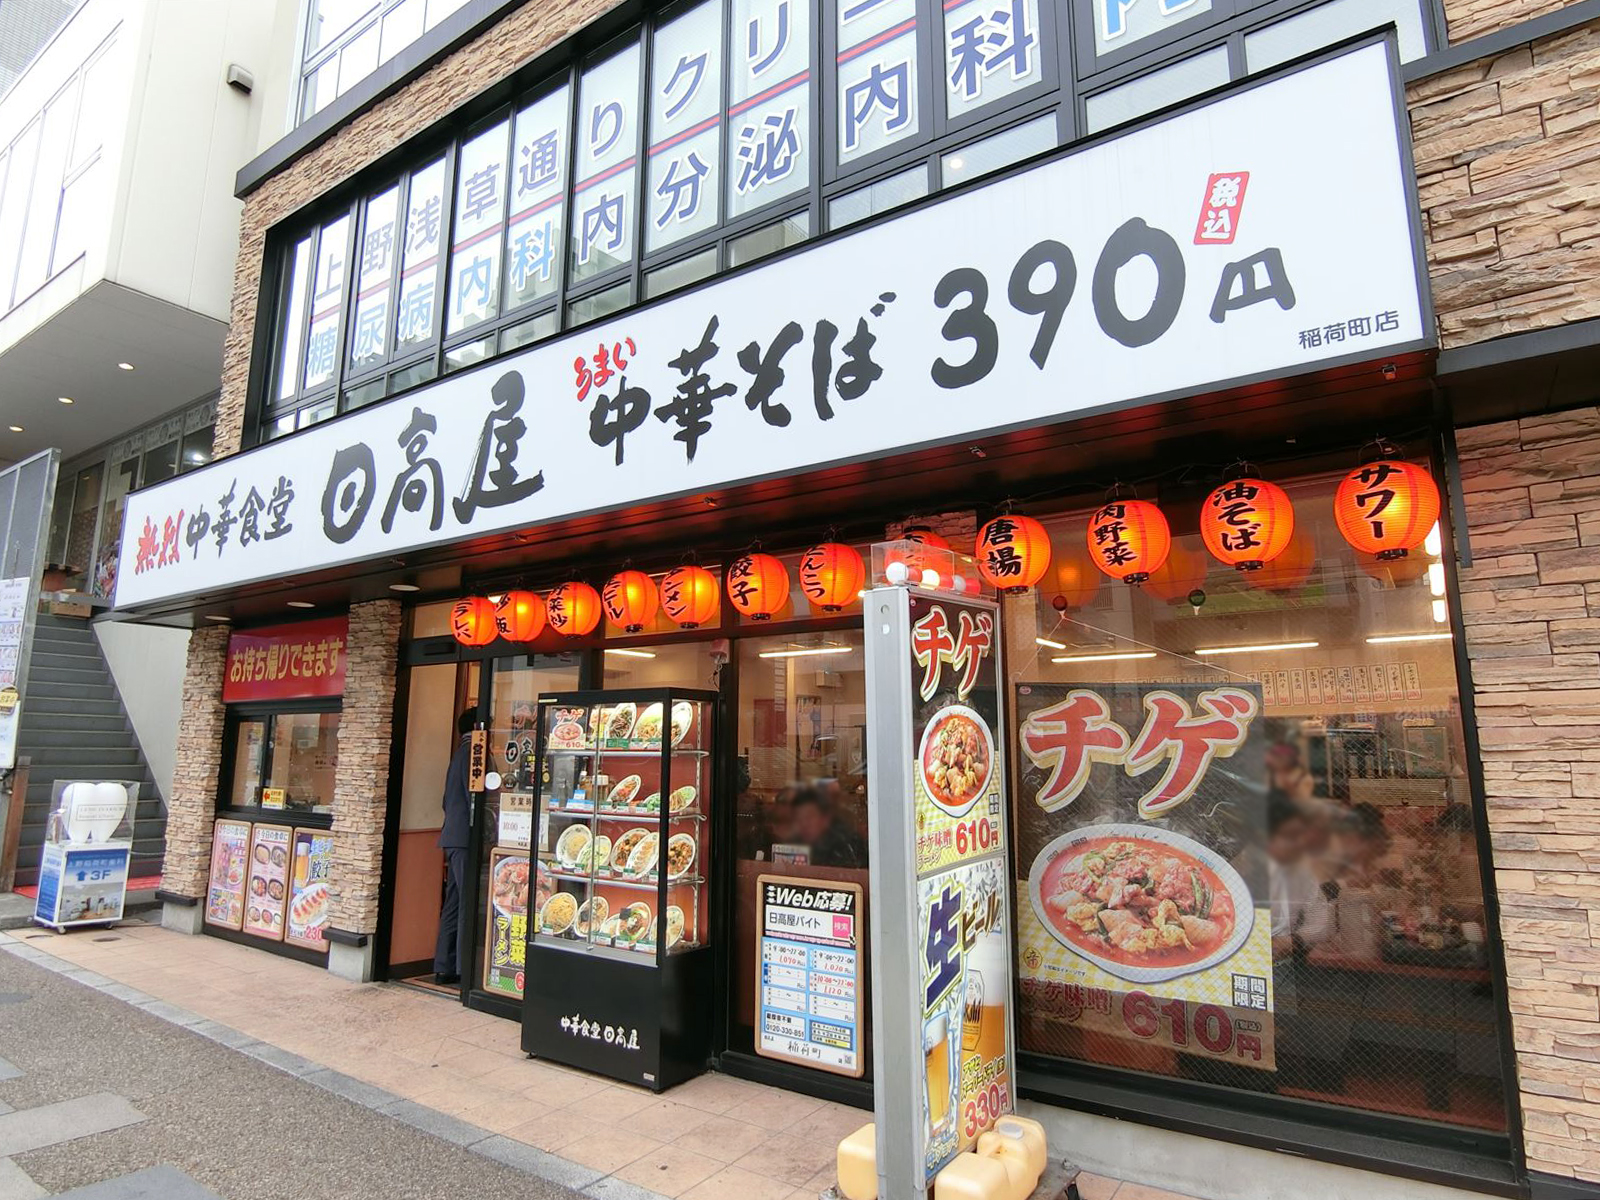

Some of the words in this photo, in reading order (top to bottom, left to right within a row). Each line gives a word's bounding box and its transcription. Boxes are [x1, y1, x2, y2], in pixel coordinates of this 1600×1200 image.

[1202, 175, 1241, 240] 税込
[589, 291, 897, 466] 中華そば
[931, 217, 1296, 389] 390円
[1298, 310, 1401, 350] 稲荷町店
[573, 336, 636, 401] うまい
[321, 370, 544, 544] 日高屋
[1212, 482, 1262, 551] 油そば
[1352, 464, 1403, 539] サワー
[983, 519, 1023, 577] 唐揚
[1093, 504, 1139, 567] 肉野菜
[729, 557, 759, 607] 餃子
[230, 637, 344, 683] お持ち帰りできます
[911, 604, 993, 702] チゲ
[1020, 687, 1259, 820] チゲ
[510, 796, 533, 807] 営業時
[955, 818, 999, 855] 610円
[90, 869, 111, 881] 3F
[494, 916, 509, 967] ラーメン
[769, 911, 821, 929] 日高屋バイト
[560, 1013, 602, 1041] 中華食堂
[963, 1083, 1009, 1138] 330円
